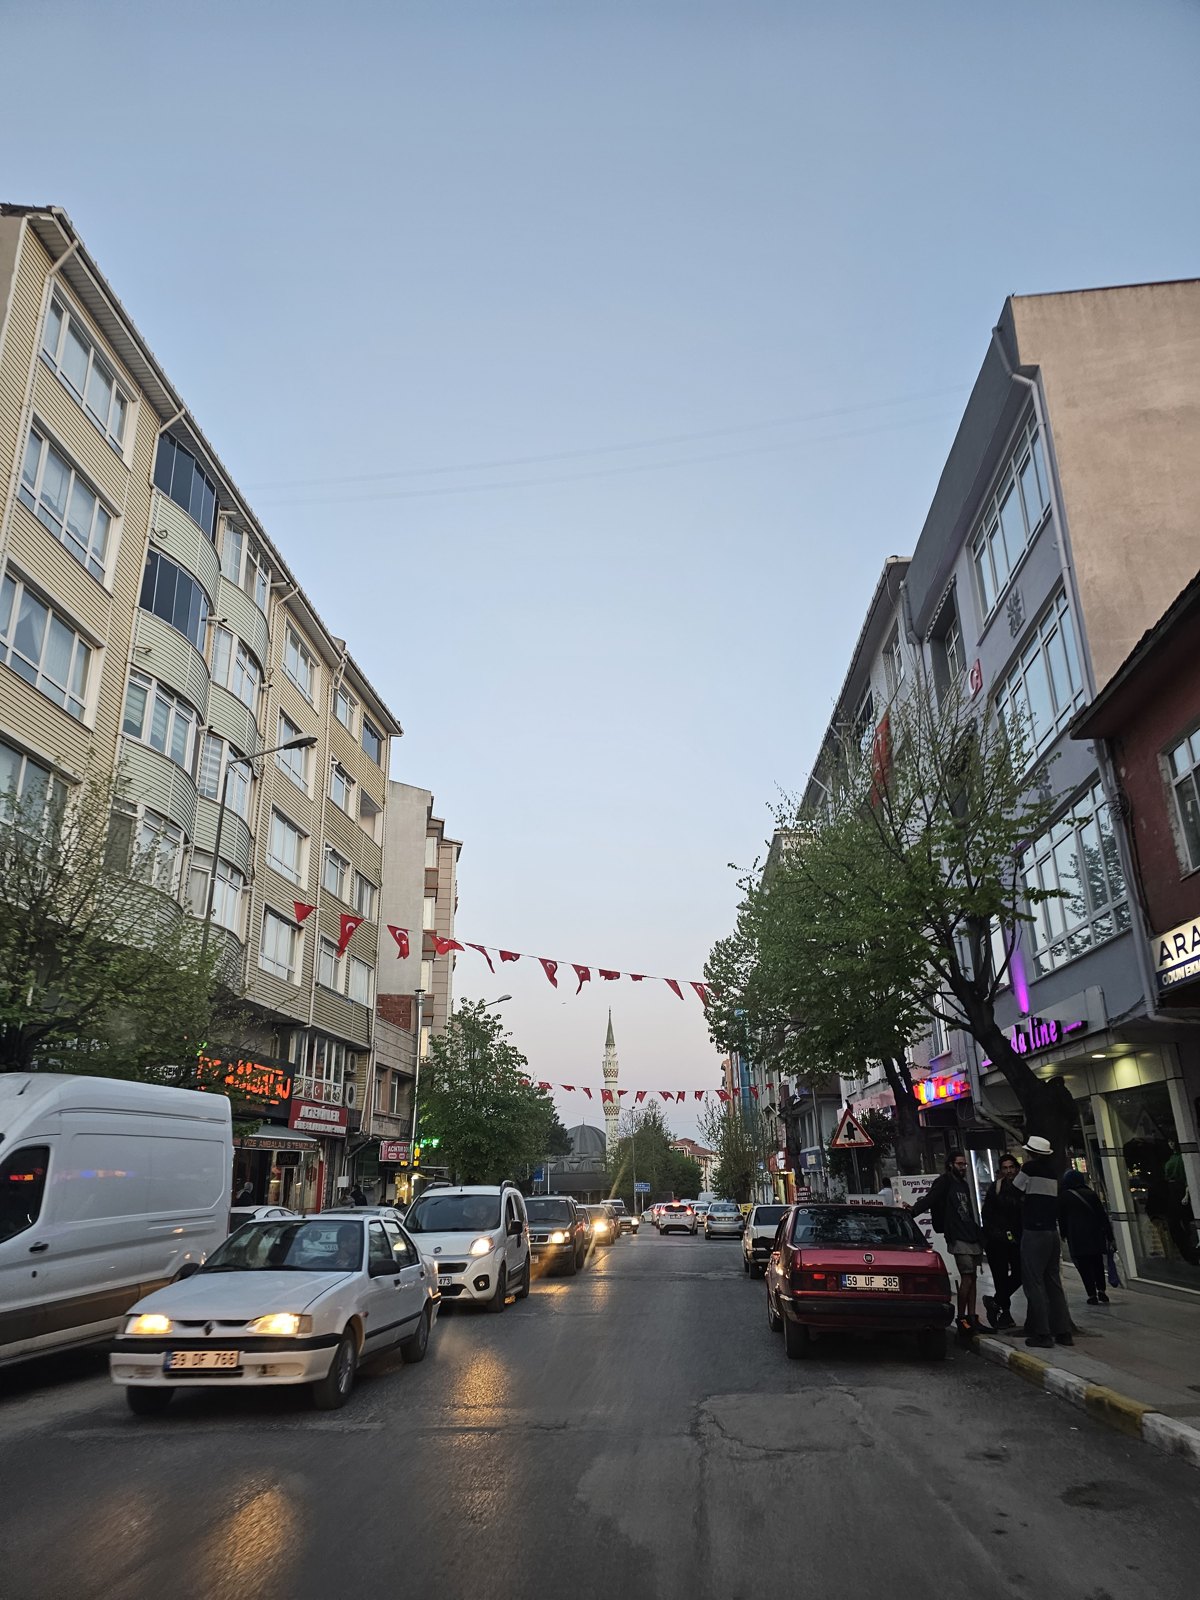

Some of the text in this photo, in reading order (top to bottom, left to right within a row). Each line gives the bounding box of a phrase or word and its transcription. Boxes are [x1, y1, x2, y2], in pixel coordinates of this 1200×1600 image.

[1028, 1017, 1058, 1051] line
[259, 1140, 286, 1149] AMBALAJ
[902, 1179, 921, 1187] Bayan
[847, 1275, 899, 1288] 59 UF 385
[171, 1352, 187, 1366] 59
